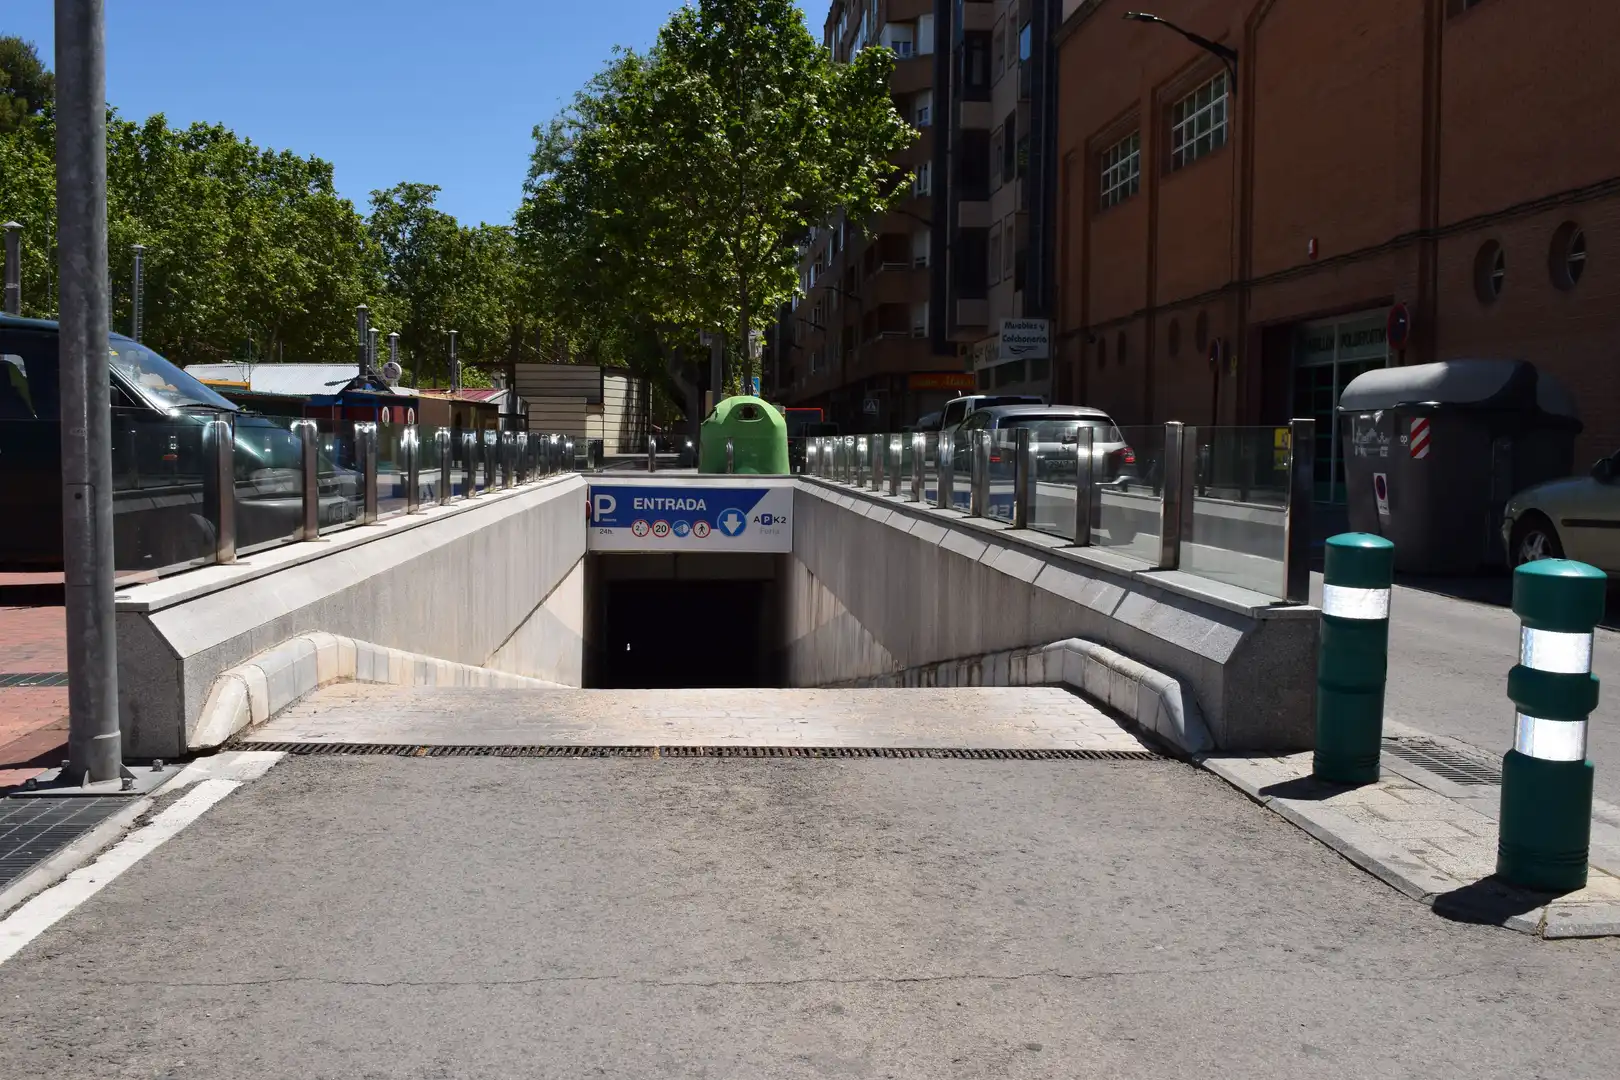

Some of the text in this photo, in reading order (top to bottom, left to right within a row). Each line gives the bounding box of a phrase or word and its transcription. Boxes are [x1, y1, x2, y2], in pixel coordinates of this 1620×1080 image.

[1004, 320, 1045, 331] Muebles y
[594, 494, 616, 522] P
[633, 497, 707, 510] ENTRADA
[656, 525, 667, 533] 20
